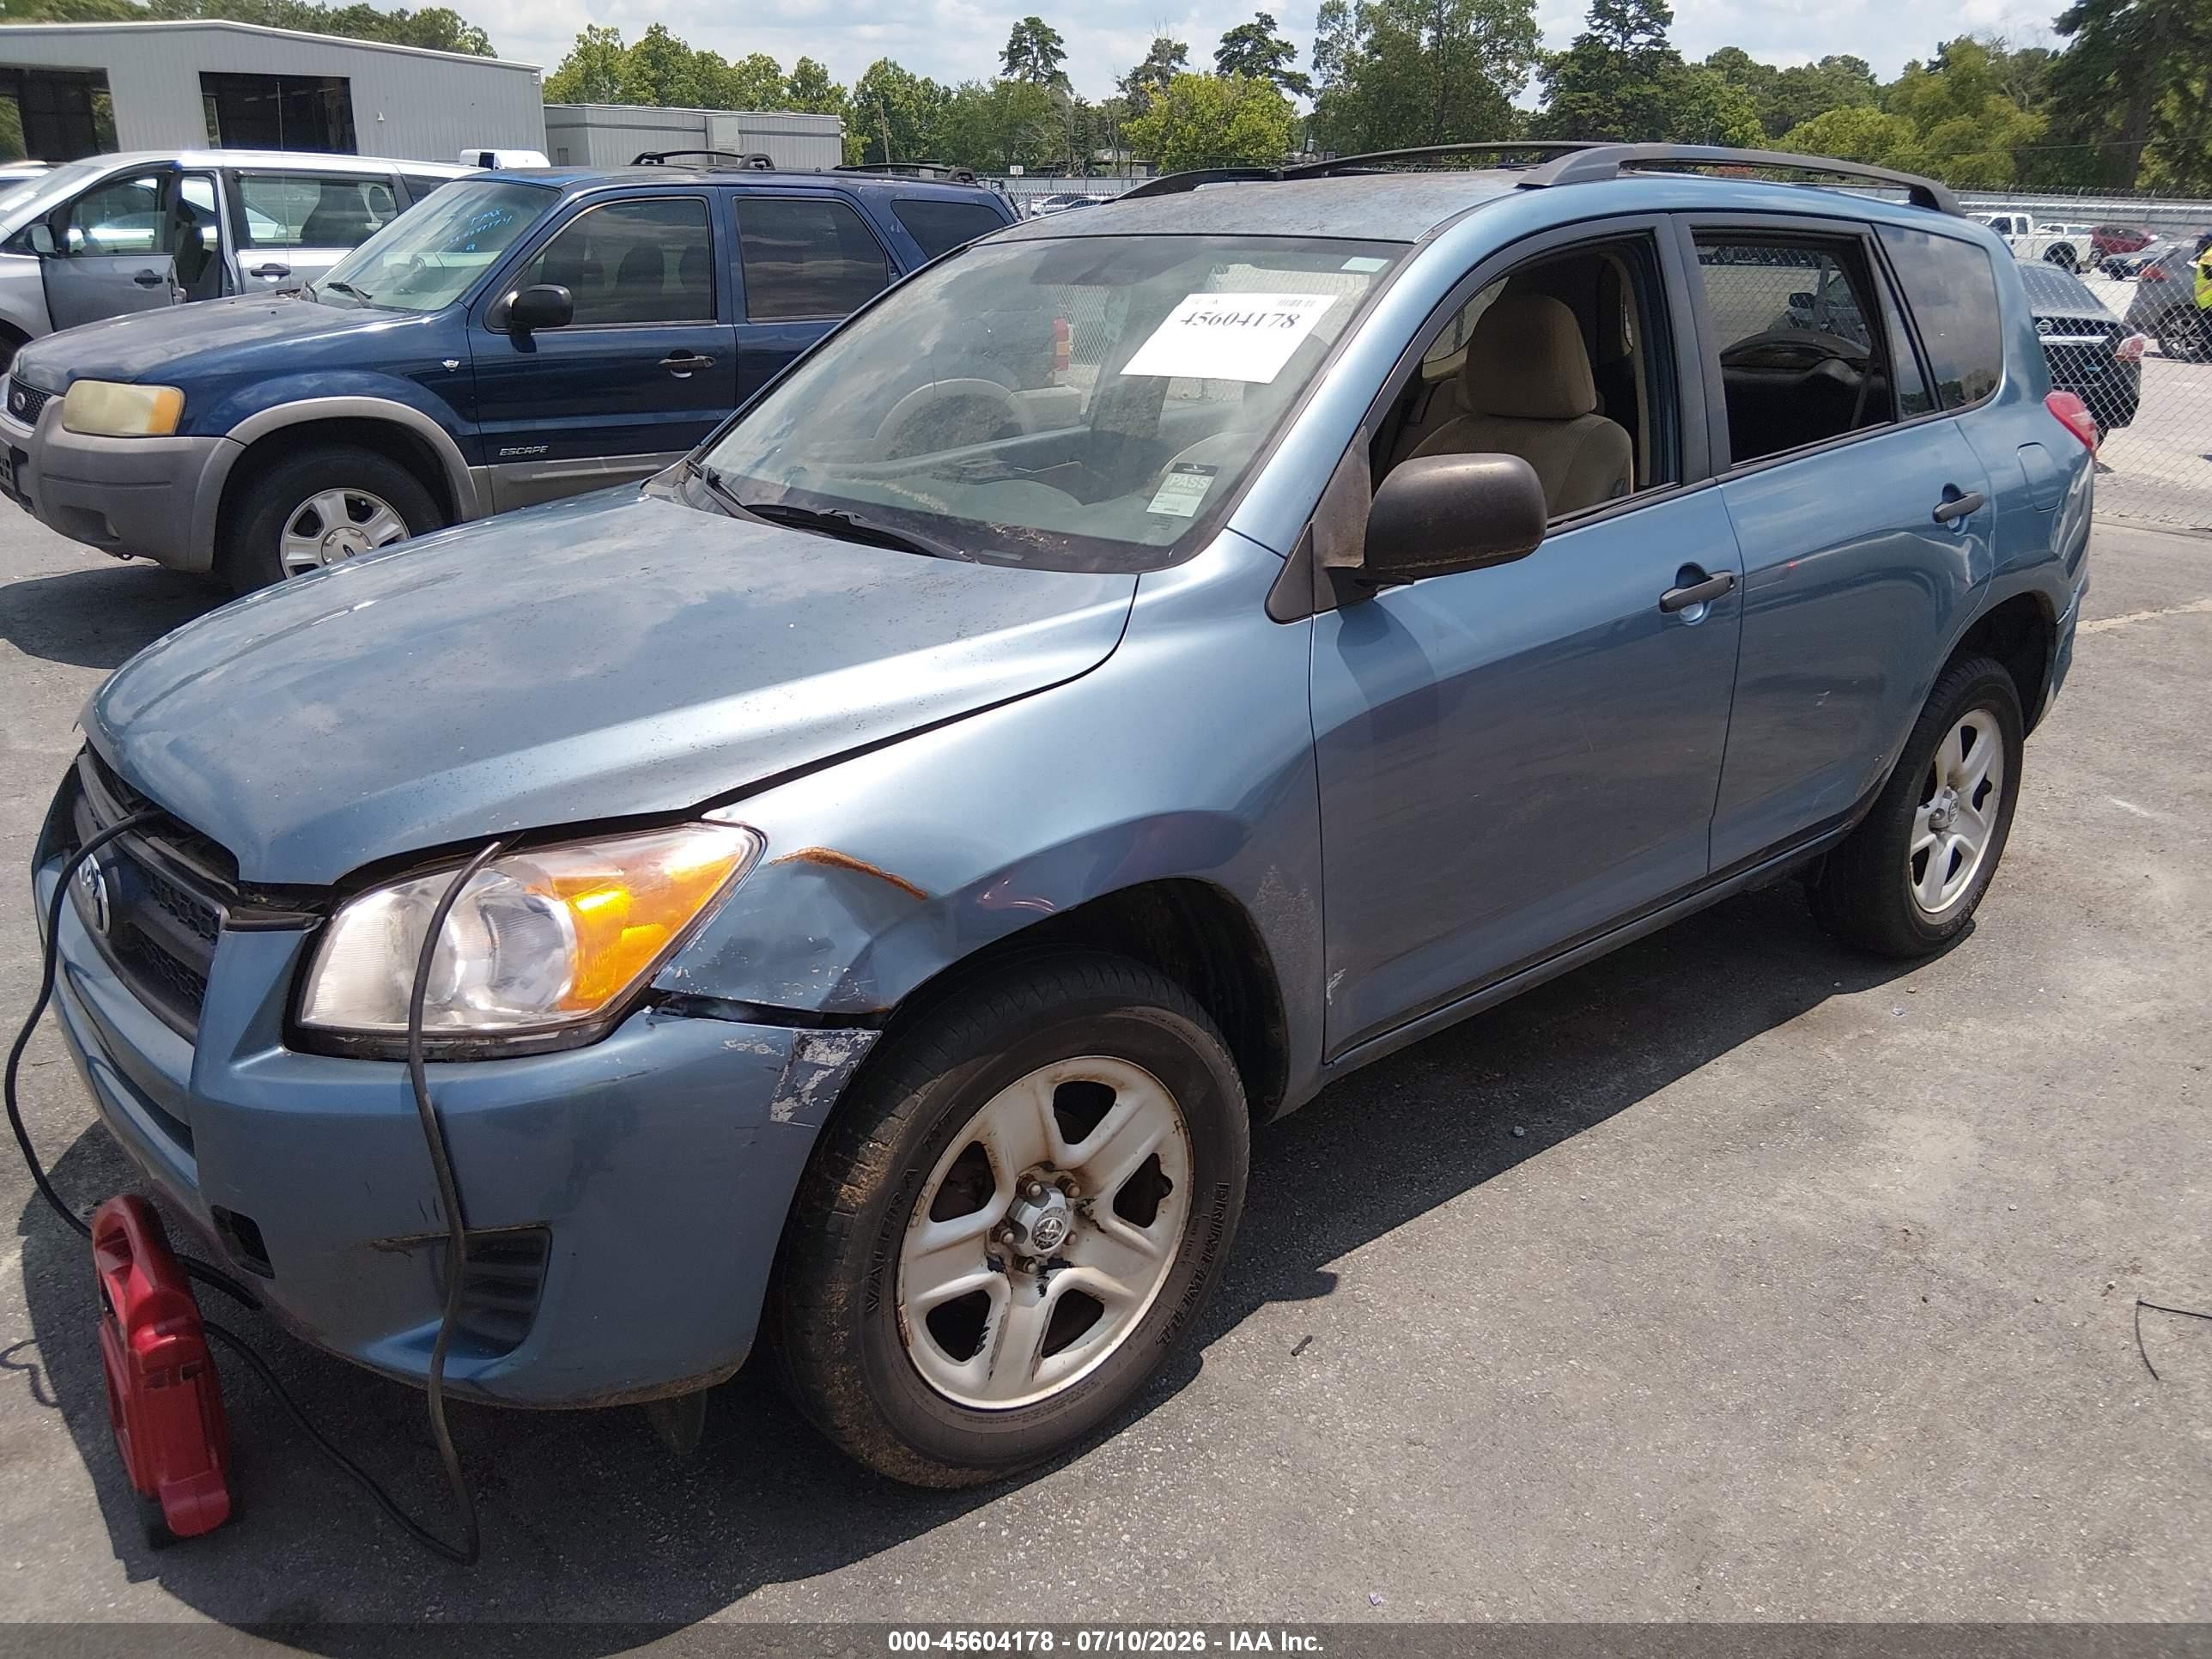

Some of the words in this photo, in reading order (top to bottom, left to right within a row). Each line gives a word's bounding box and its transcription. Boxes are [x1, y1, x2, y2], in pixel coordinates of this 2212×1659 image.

[1180, 311, 1301, 329] 45604178
[498, 445, 550, 457] ESCAPE
[1168, 474, 1210, 489] PASS
[1155, 1182, 1231, 1346] PRIMEWELL
